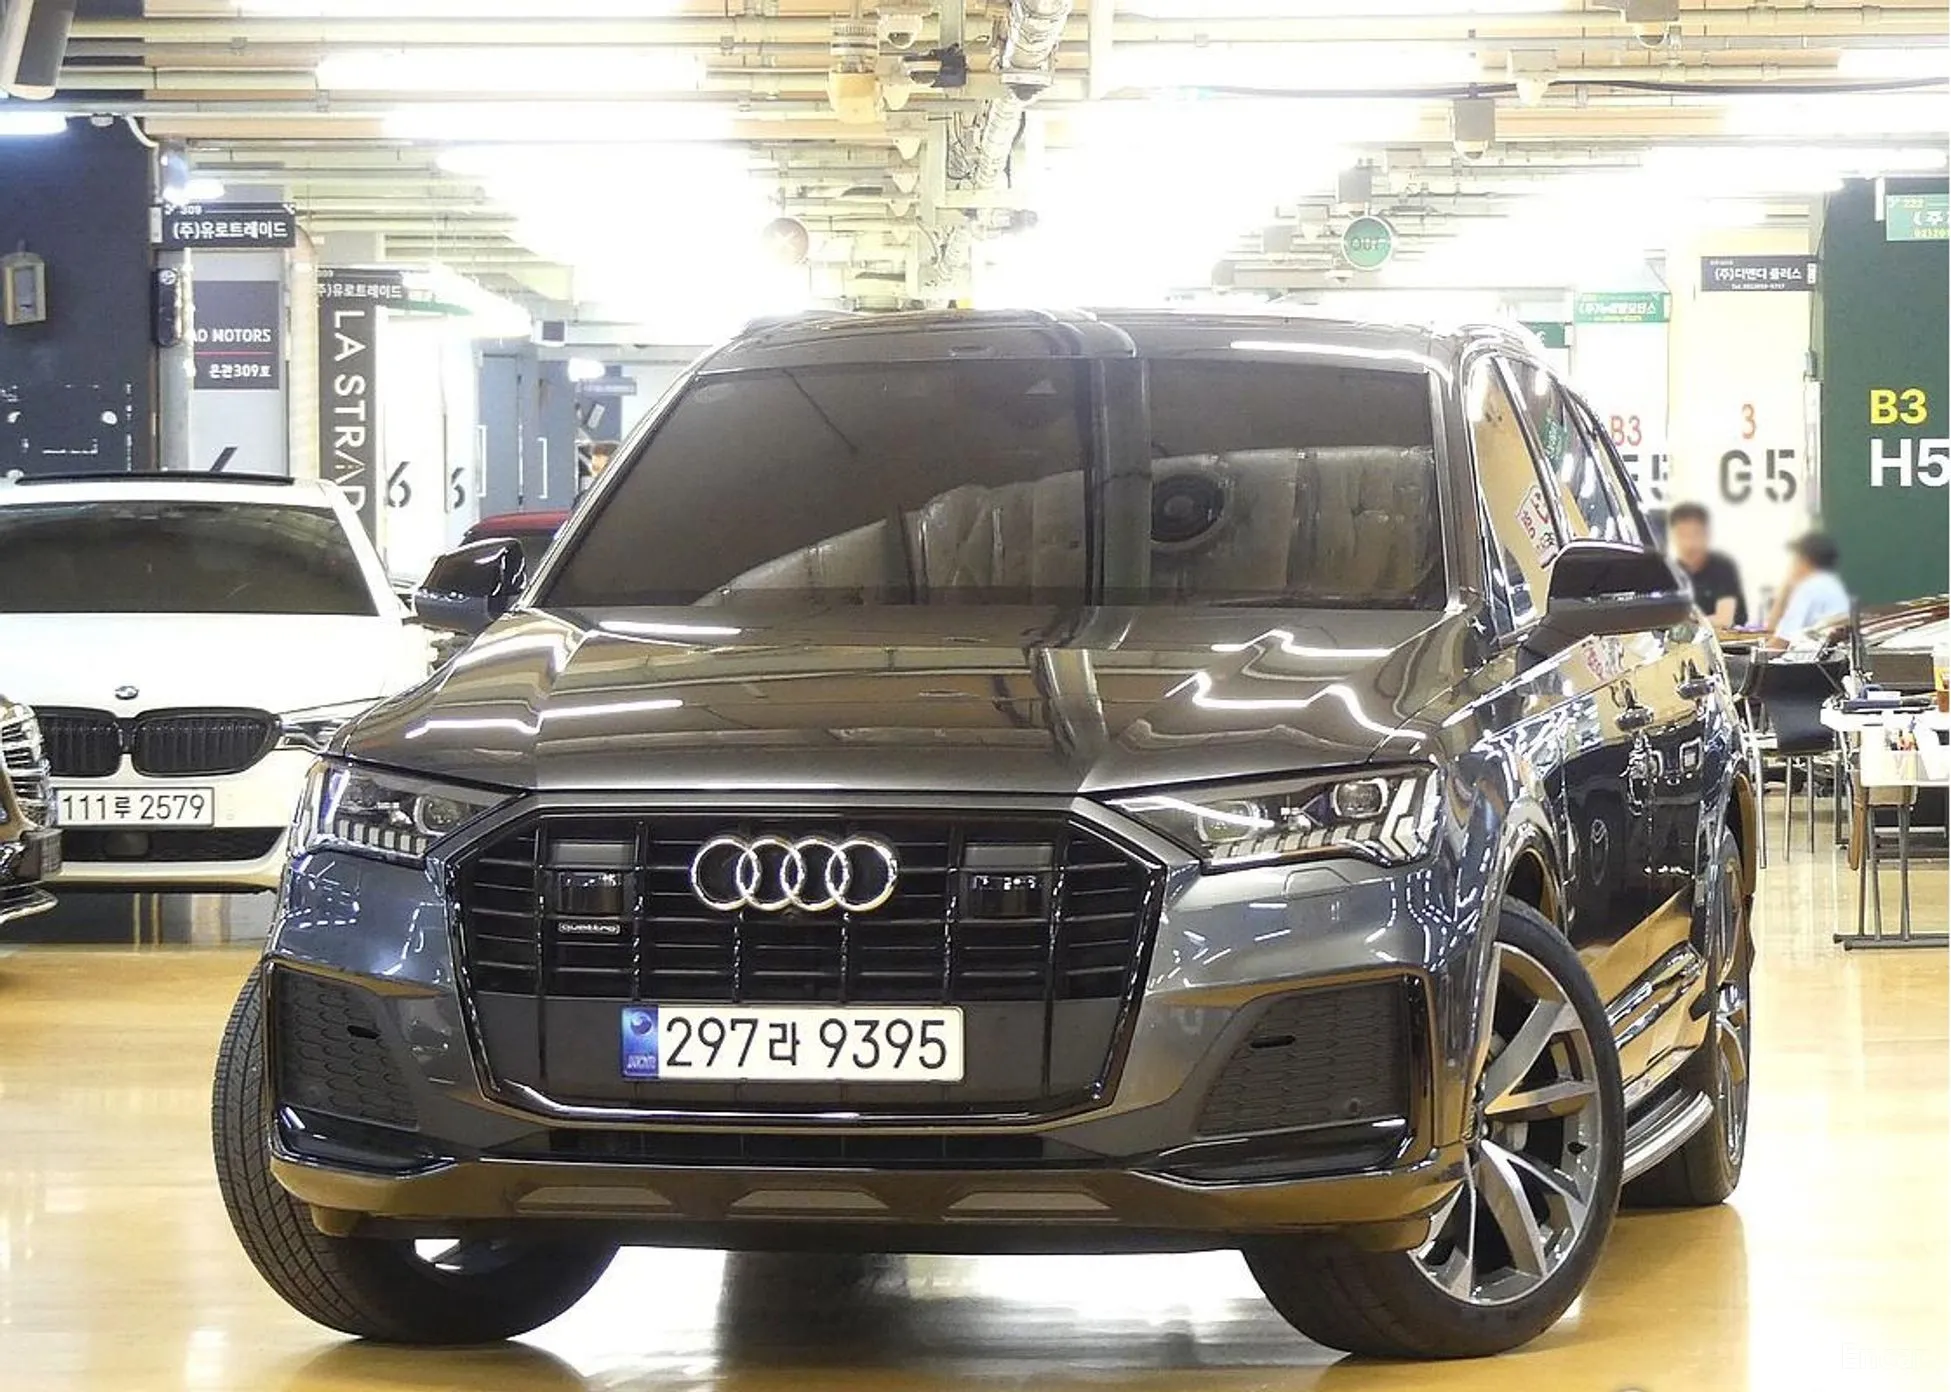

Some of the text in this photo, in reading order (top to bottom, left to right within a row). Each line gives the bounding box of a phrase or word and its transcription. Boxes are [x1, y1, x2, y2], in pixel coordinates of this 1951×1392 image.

[172, 220, 289, 240] (주)유로트레이드
[1913, 210, 1949, 227] (주
[1350, 236, 1388, 251] OUT
[1769, 267, 1802, 281] 플러스
[212, 327, 271, 342] MOTORS
[333, 310, 368, 362] LA
[1869, 388, 1928, 426] B3
[1610, 415, 1642, 447] B3
[1719, 449, 1798, 504] G5
[1869, 437, 1949, 487] H5
[387, 460, 412, 508] 6
[63, 795, 205, 820] 111루 2579
[665, 1016, 947, 1070] 297라 9395
